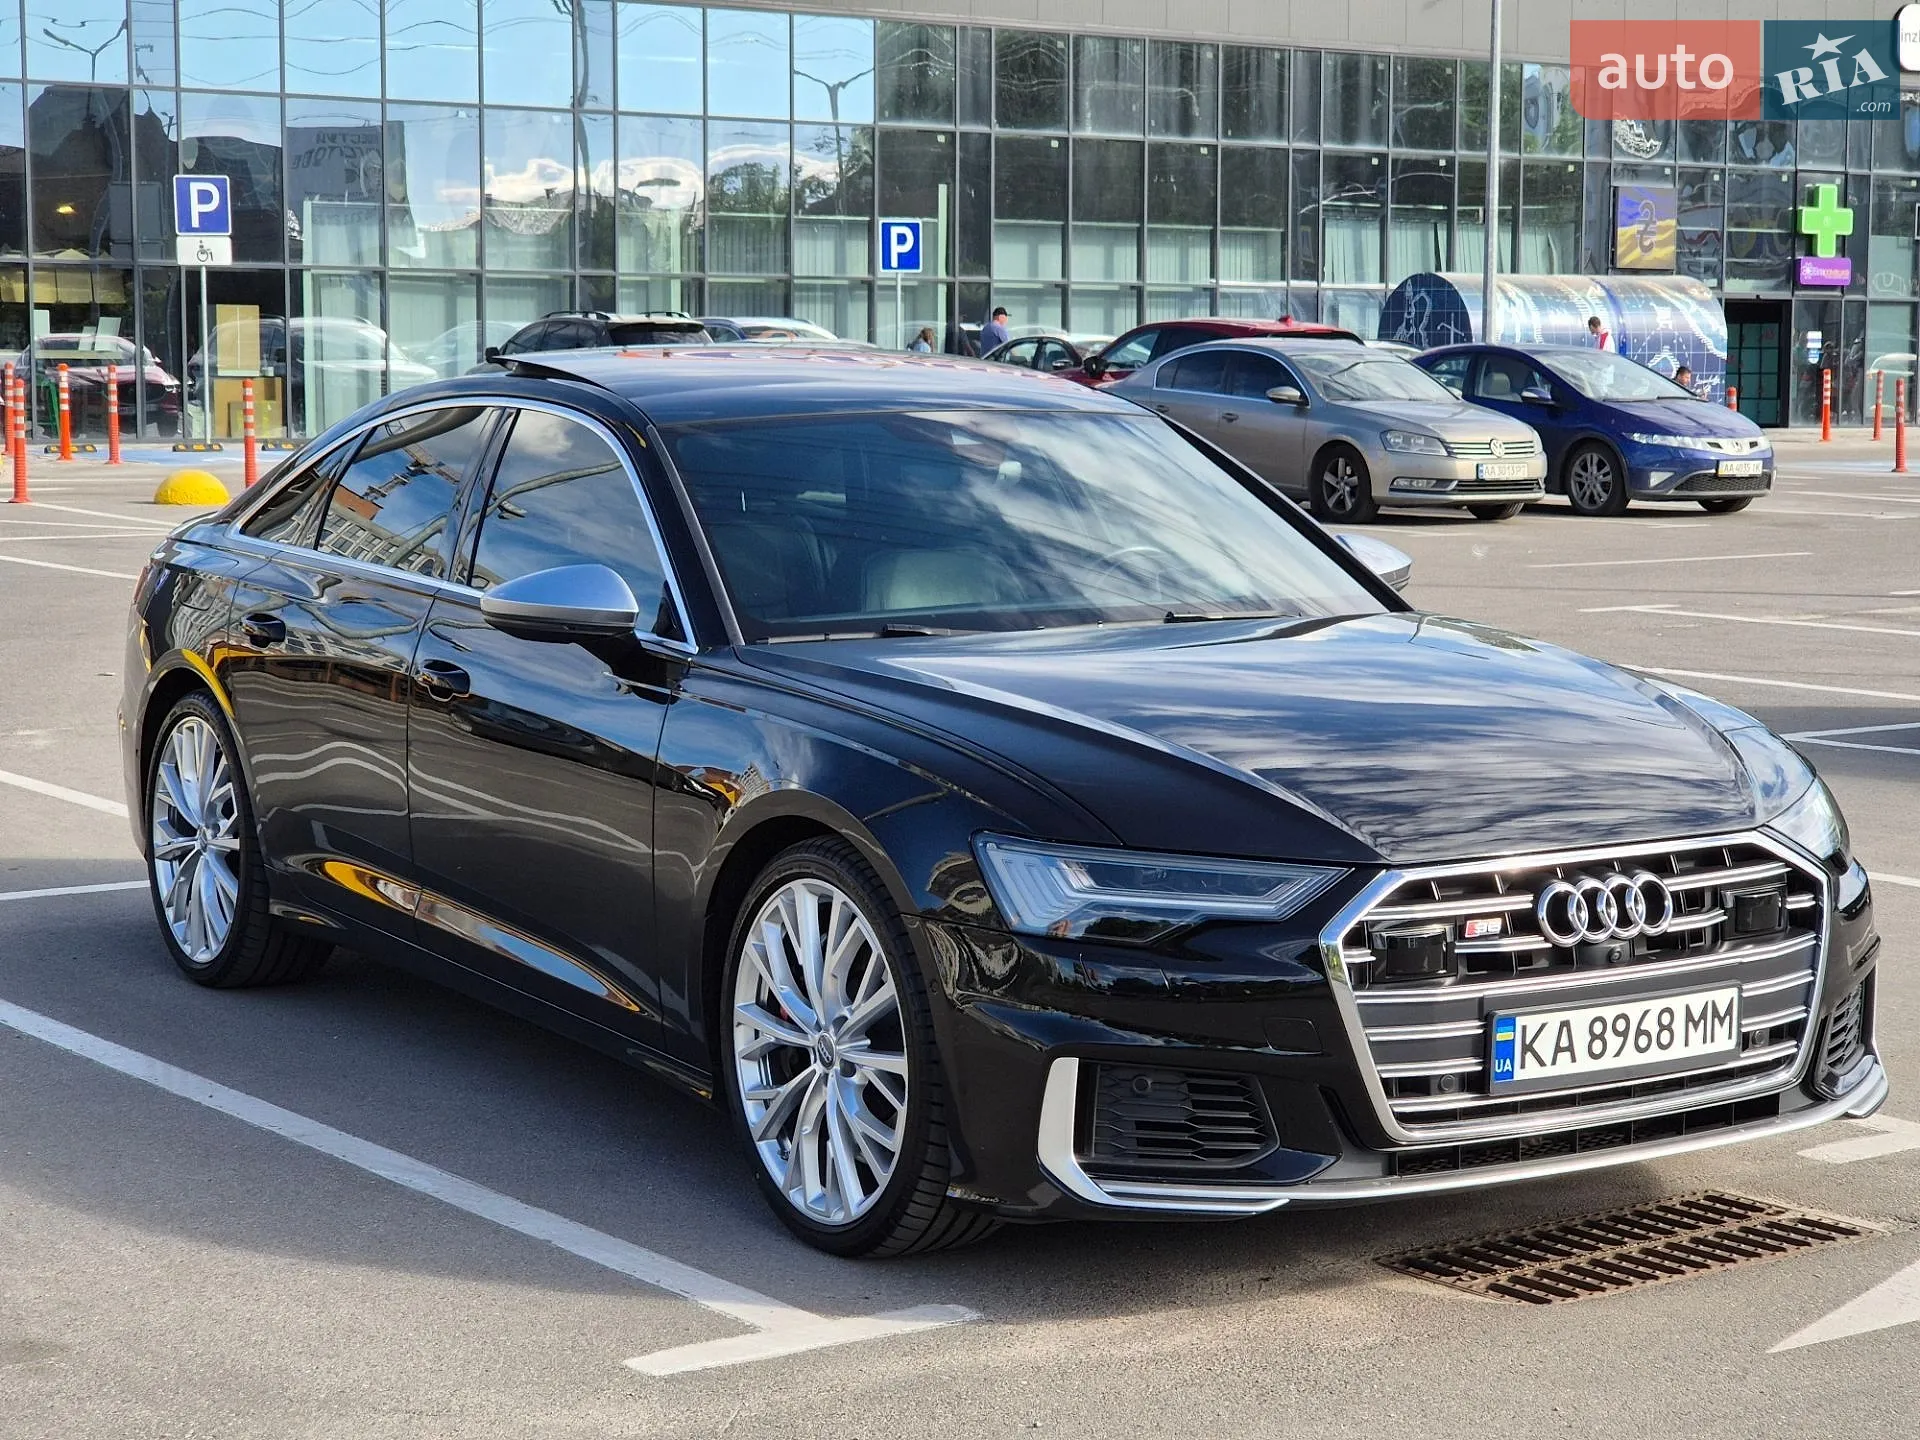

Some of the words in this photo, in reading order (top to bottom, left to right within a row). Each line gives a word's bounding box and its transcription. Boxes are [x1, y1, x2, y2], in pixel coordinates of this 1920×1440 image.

[189, 181, 220, 228] P
[890, 225, 915, 268] P
[1519, 1019, 1578, 1070] KA
[1587, 1006, 1675, 1060] 8968
[1684, 996, 1735, 1047] MM
[1495, 1057, 1513, 1073] UA
